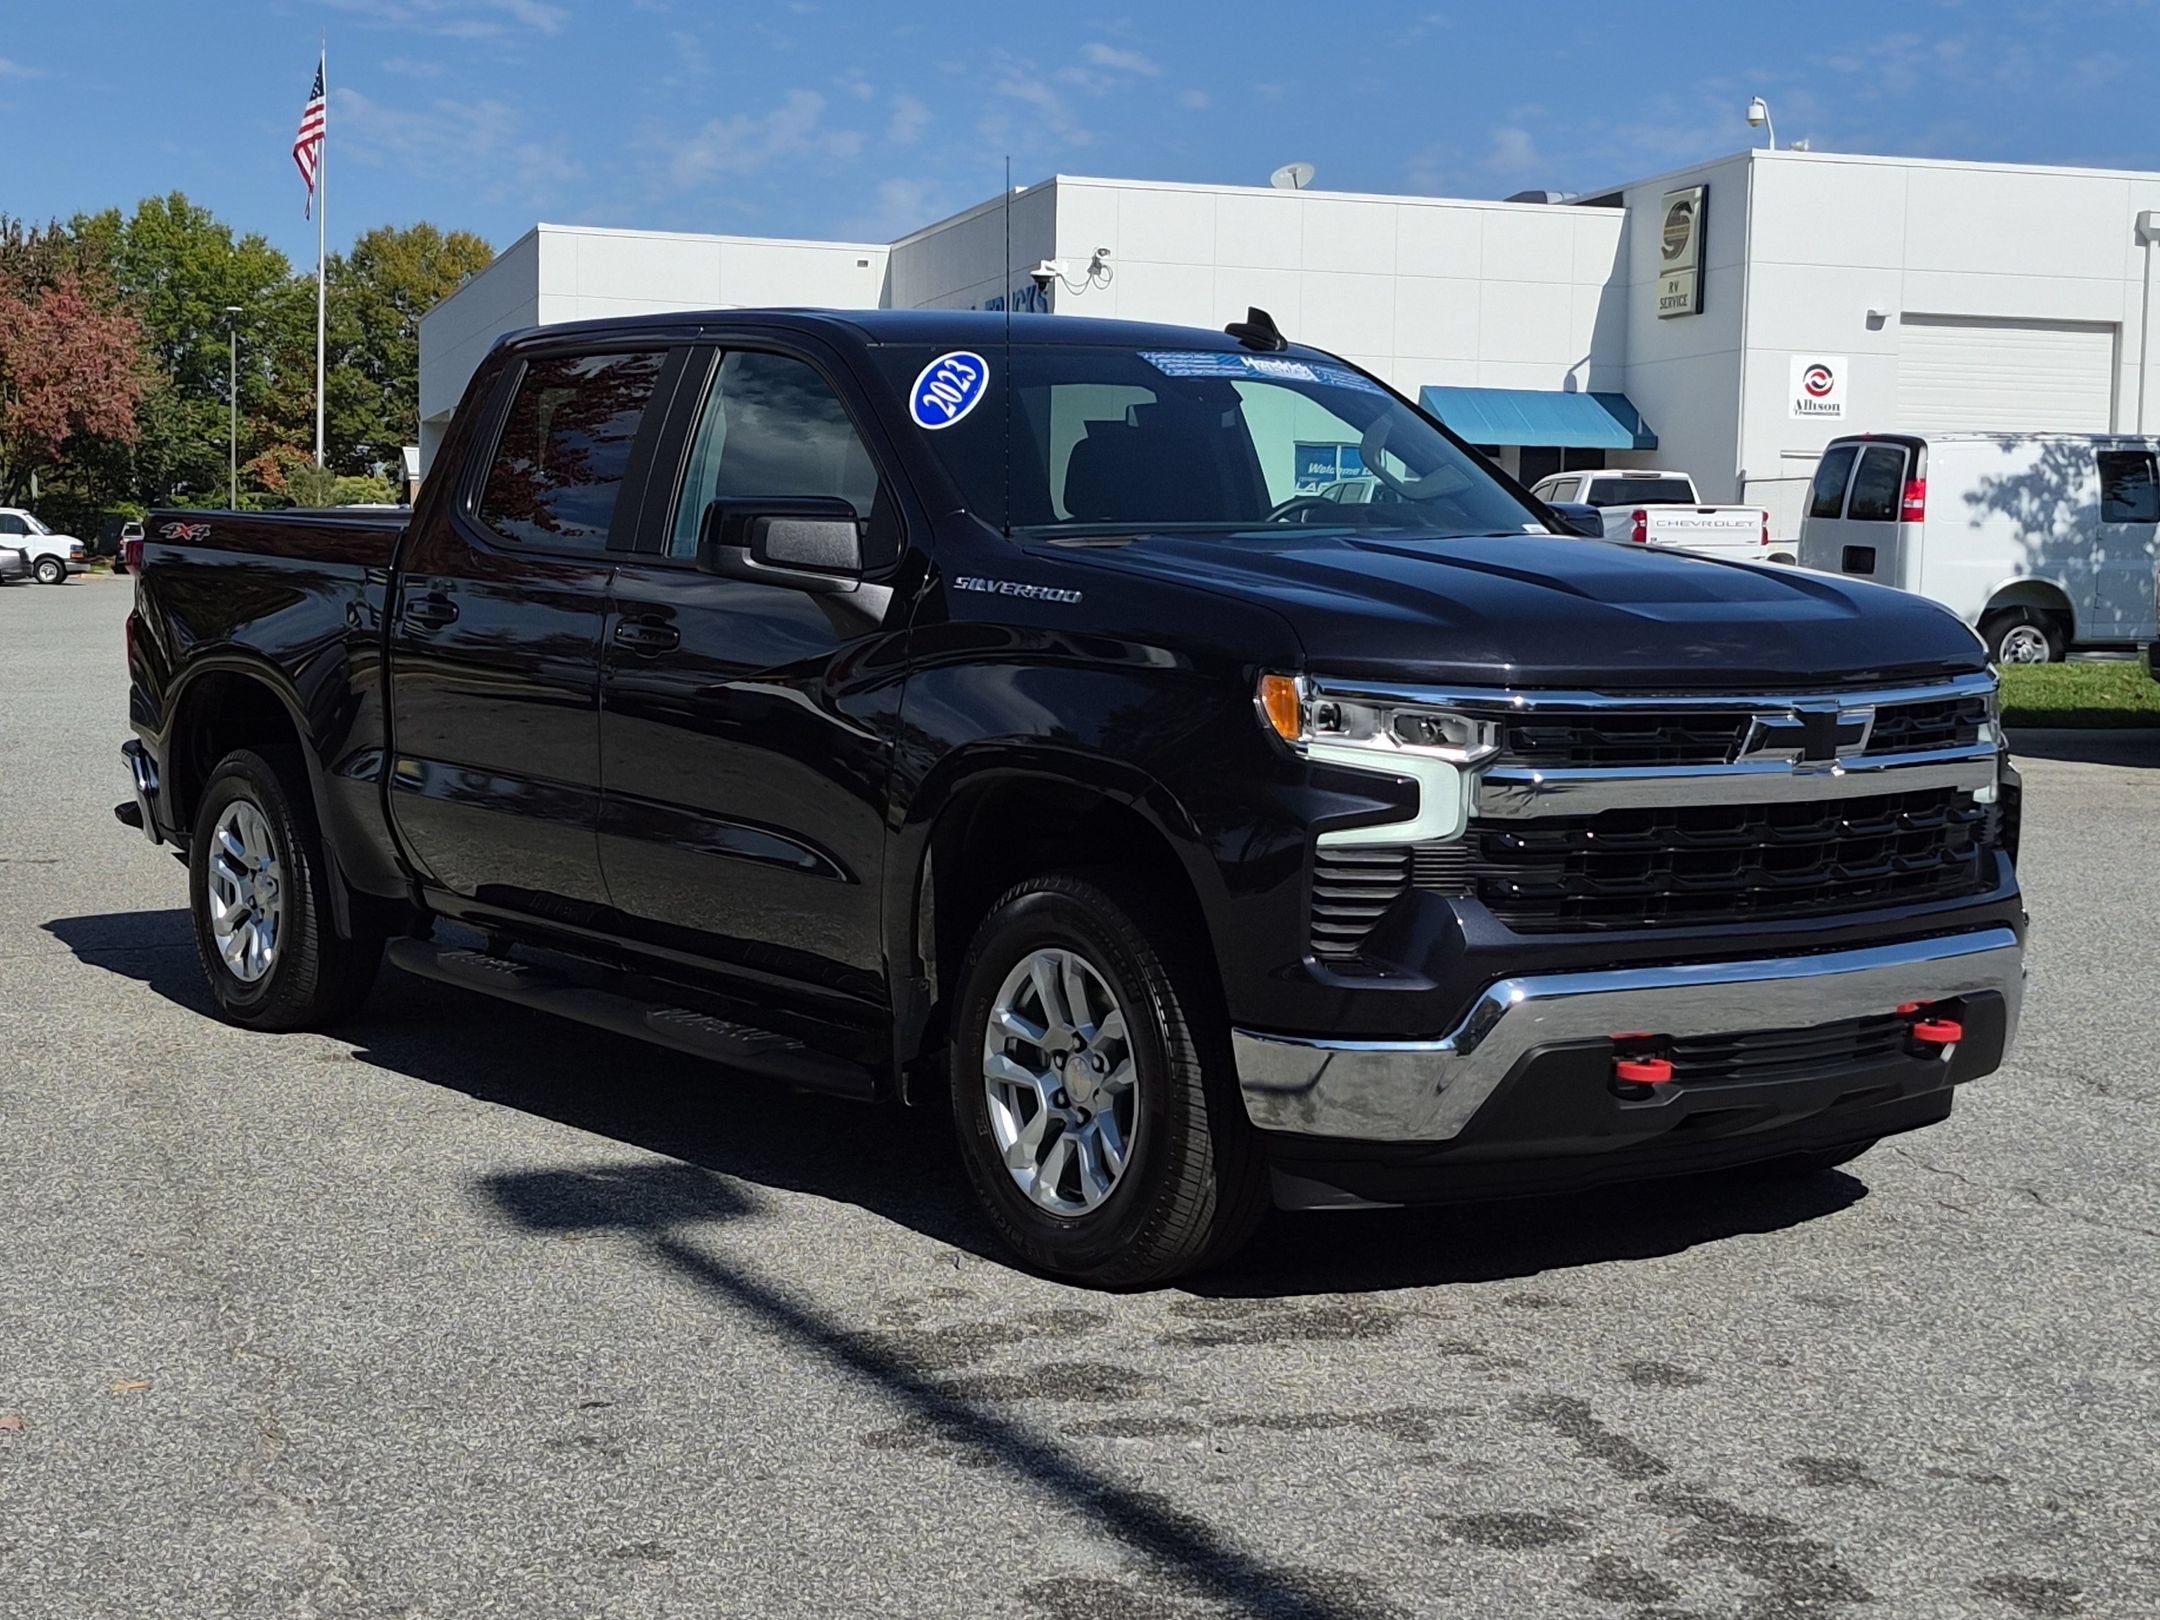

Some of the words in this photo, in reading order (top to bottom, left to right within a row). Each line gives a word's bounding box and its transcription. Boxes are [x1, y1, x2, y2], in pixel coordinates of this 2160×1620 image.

[1668, 281, 1680, 294] RV
[1660, 294, 1688, 309] SERVICE
[923, 359, 976, 418] 2023
[1794, 398, 1840, 411] Allison
[952, 576, 1084, 604] SILVERADO
